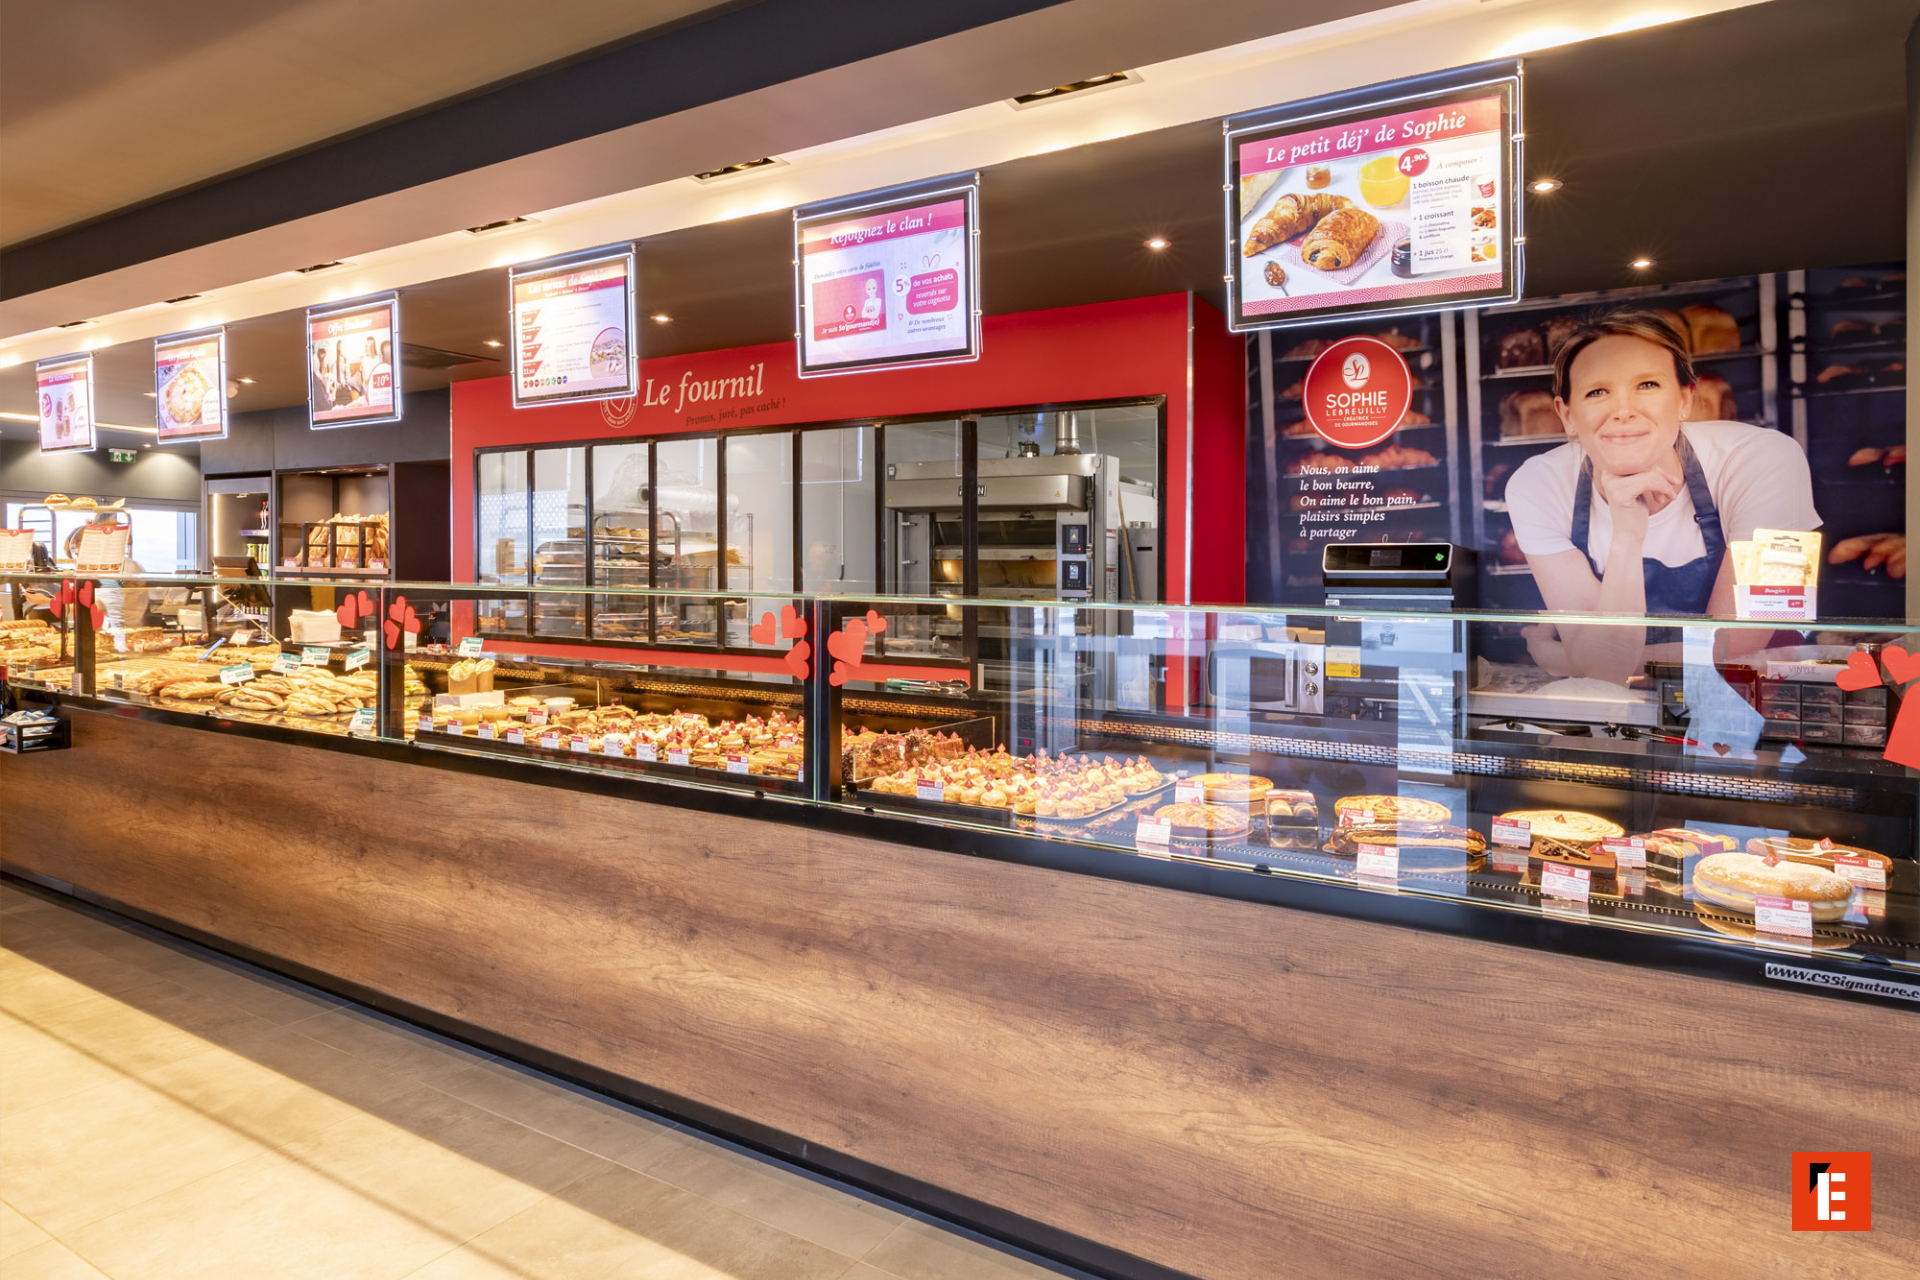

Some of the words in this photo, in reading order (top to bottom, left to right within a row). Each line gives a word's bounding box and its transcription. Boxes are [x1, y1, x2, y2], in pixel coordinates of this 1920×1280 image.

[1266, 147, 1285, 164] Le
[1290, 136, 1331, 163] petit
[1374, 124, 1396, 143] de
[1402, 112, 1466, 140] Sophie
[1418, 179, 1444, 188] boisson
[1445, 175, 1469, 184] chaude
[1424, 210, 1454, 220] croissant
[830, 226, 882, 245] Rejoignez
[886, 220, 897, 233] le
[900, 217, 923, 231] clan
[927, 213, 932, 226] !
[1424, 249, 1434, 257] jus
[568, 275, 578, 287] de
[913, 278, 921, 287] de
[922, 277, 932, 286] vos
[933, 272, 954, 283] achats
[643, 379, 670, 406] Le
[674, 363, 764, 413] fournil
[1326, 391, 1387, 408] SOPHIE
[686, 411, 716, 426] Promis,
[718, 408, 737, 424] juré,
[740, 405, 754, 419] pas
[757, 398, 780, 412] caché
[1326, 407, 1387, 416] LEBREUILLY
[1300, 465, 1332, 476] Nous,
[1335, 466, 1349, 474] on
[1352, 462, 1380, 474] aime
[1300, 480, 1309, 490] le
[1313, 480, 1332, 490] bon
[1336, 479, 1374, 491] beurre,
[1300, 496, 1316, 506] On
[1320, 495, 1346, 506] aime
[1350, 494, 1360, 505] le
[1363, 494, 1384, 505] bon
[1387, 493, 1417, 508] pain,
[1299, 510, 1340, 525] plaisirs
[1344, 509, 1385, 524] simples
[1300, 526, 1307, 537] à
[1309, 528, 1357, 541] partager
[1788, 666, 1816, 674] VINYLE
